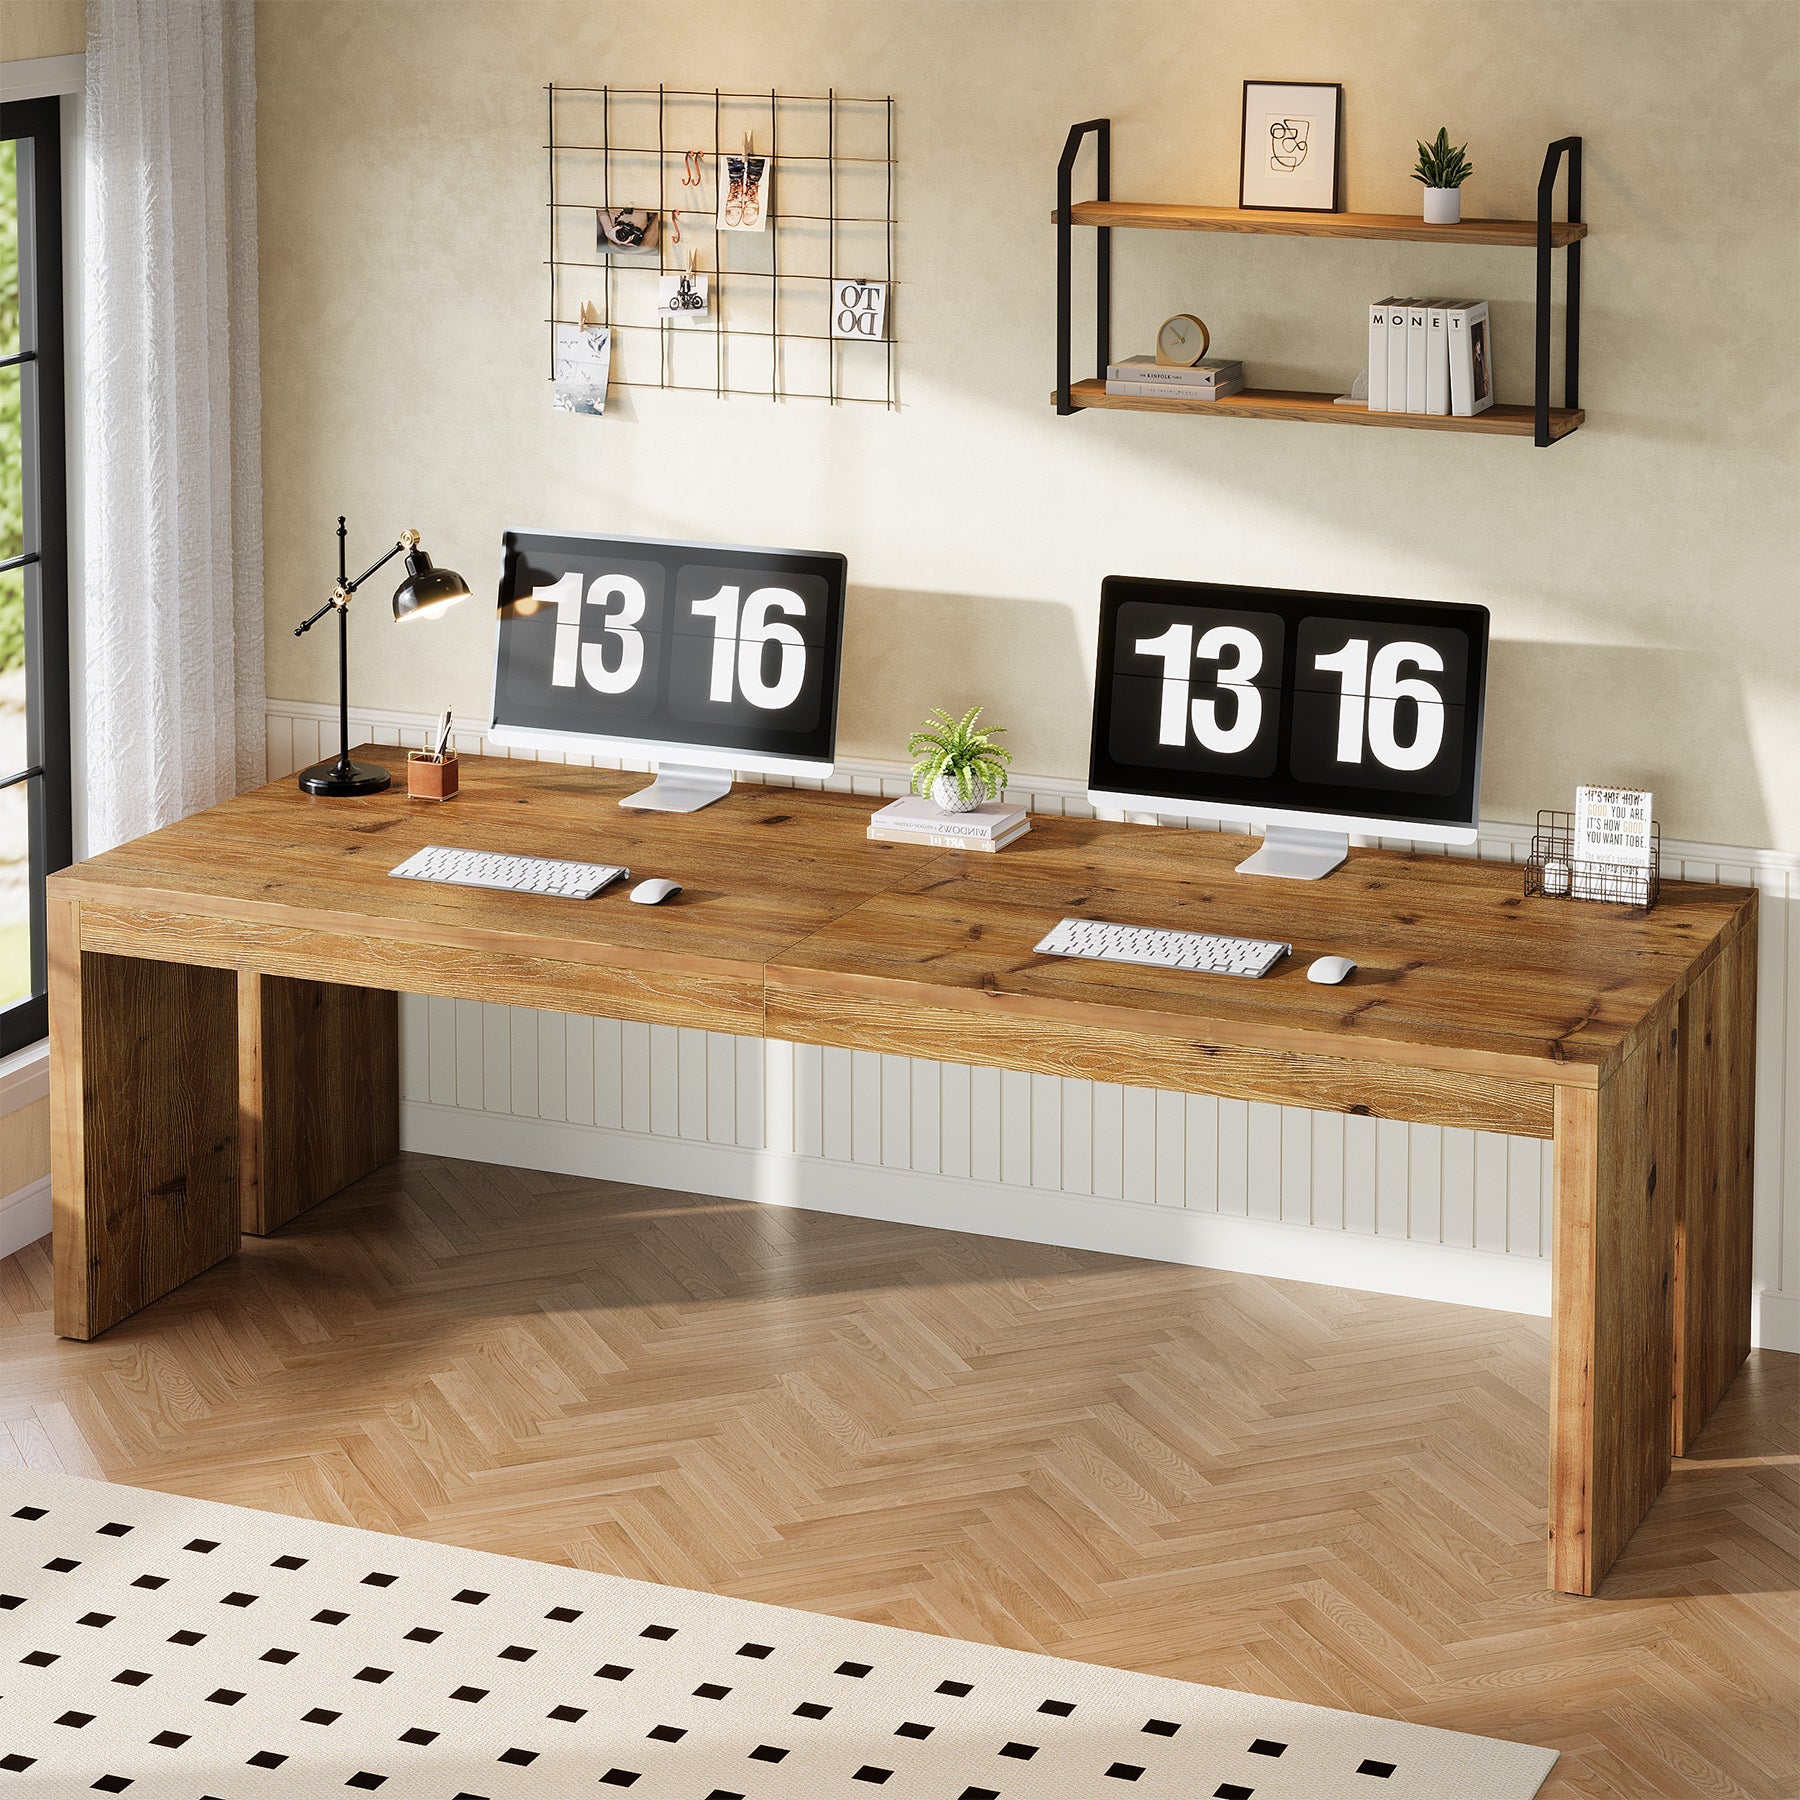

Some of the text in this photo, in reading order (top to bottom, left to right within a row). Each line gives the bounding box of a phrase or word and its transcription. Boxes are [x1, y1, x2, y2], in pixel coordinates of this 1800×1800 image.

[532, 572, 807, 710] 13 16
[1135, 623, 1445, 771] 13 16
[1588, 790, 1640, 806] IT'S NOT HOW
[1587, 803, 1607, 817] GOOD
[1612, 806, 1626, 818] YOU
[1587, 817, 1643, 833] IT'S HOW GOOD
[1586, 831, 1601, 843] YOU
[1603, 832, 1623, 845] WANT
